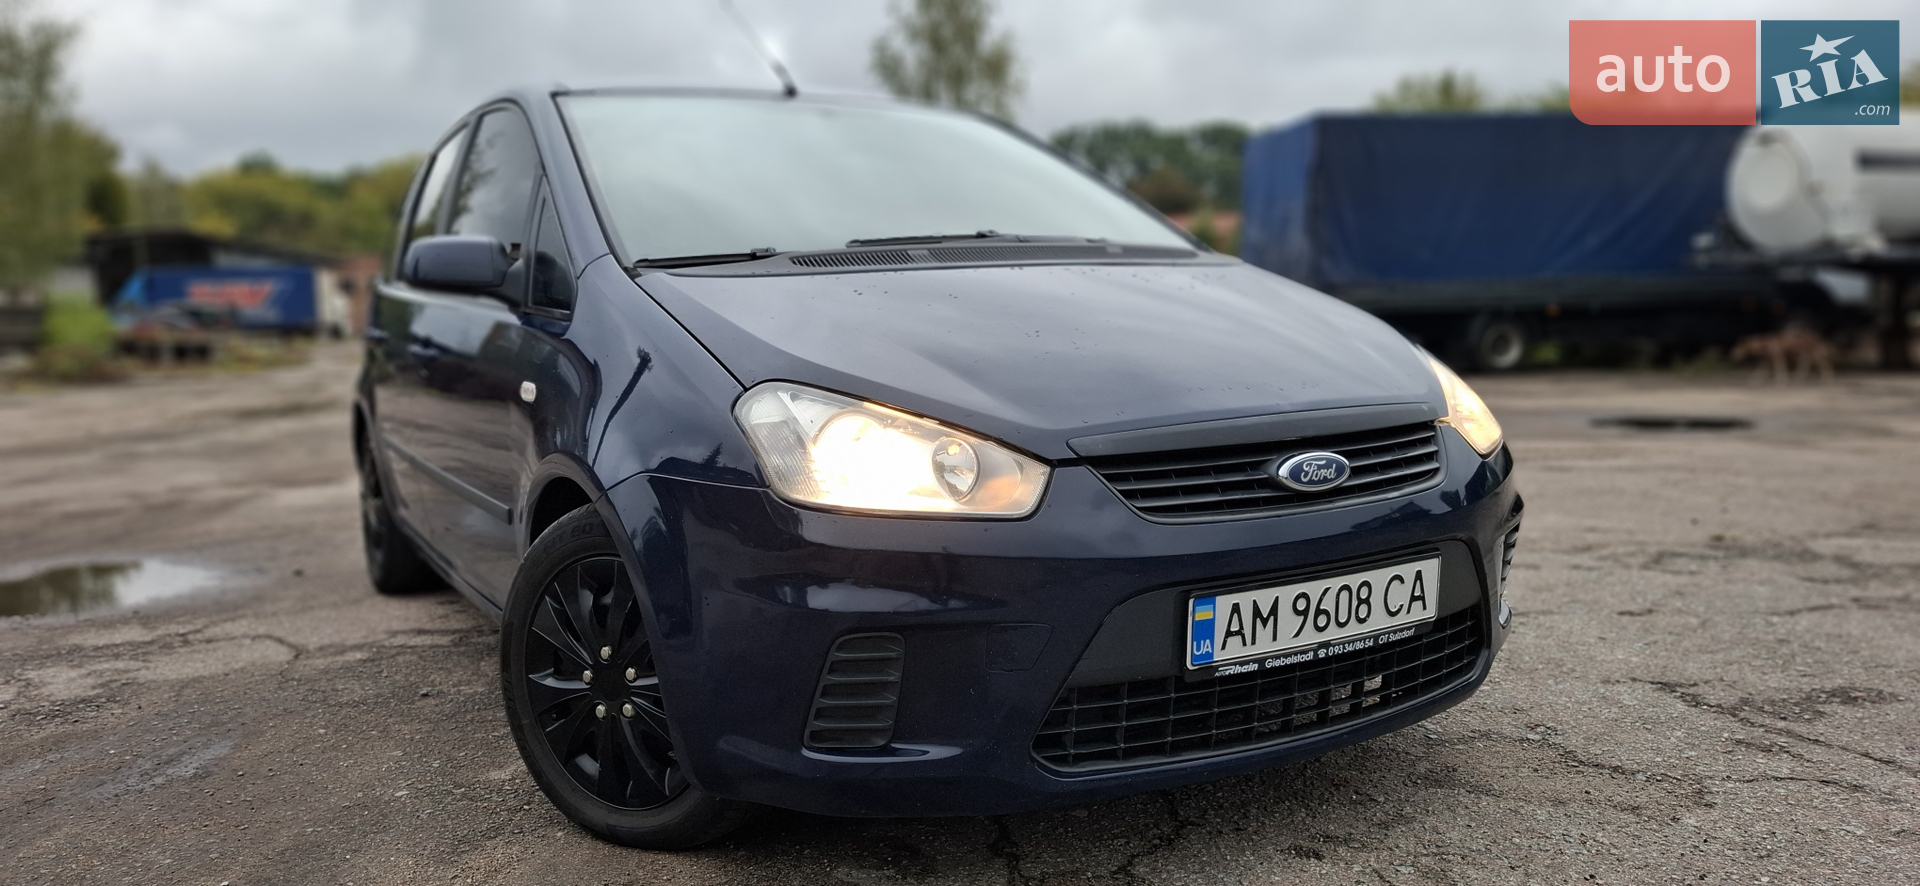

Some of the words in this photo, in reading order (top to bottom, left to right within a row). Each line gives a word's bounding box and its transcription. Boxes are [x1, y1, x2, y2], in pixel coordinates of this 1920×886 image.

[1301, 460, 1336, 482] Ford
[1220, 595, 1280, 651] AM
[1291, 579, 1373, 639] 9608
[1383, 569, 1428, 618] CA
[1193, 639, 1213, 656] UA
[1265, 651, 1314, 668] Giebelstadt
[1388, 627, 1415, 642] Sulzdorf
